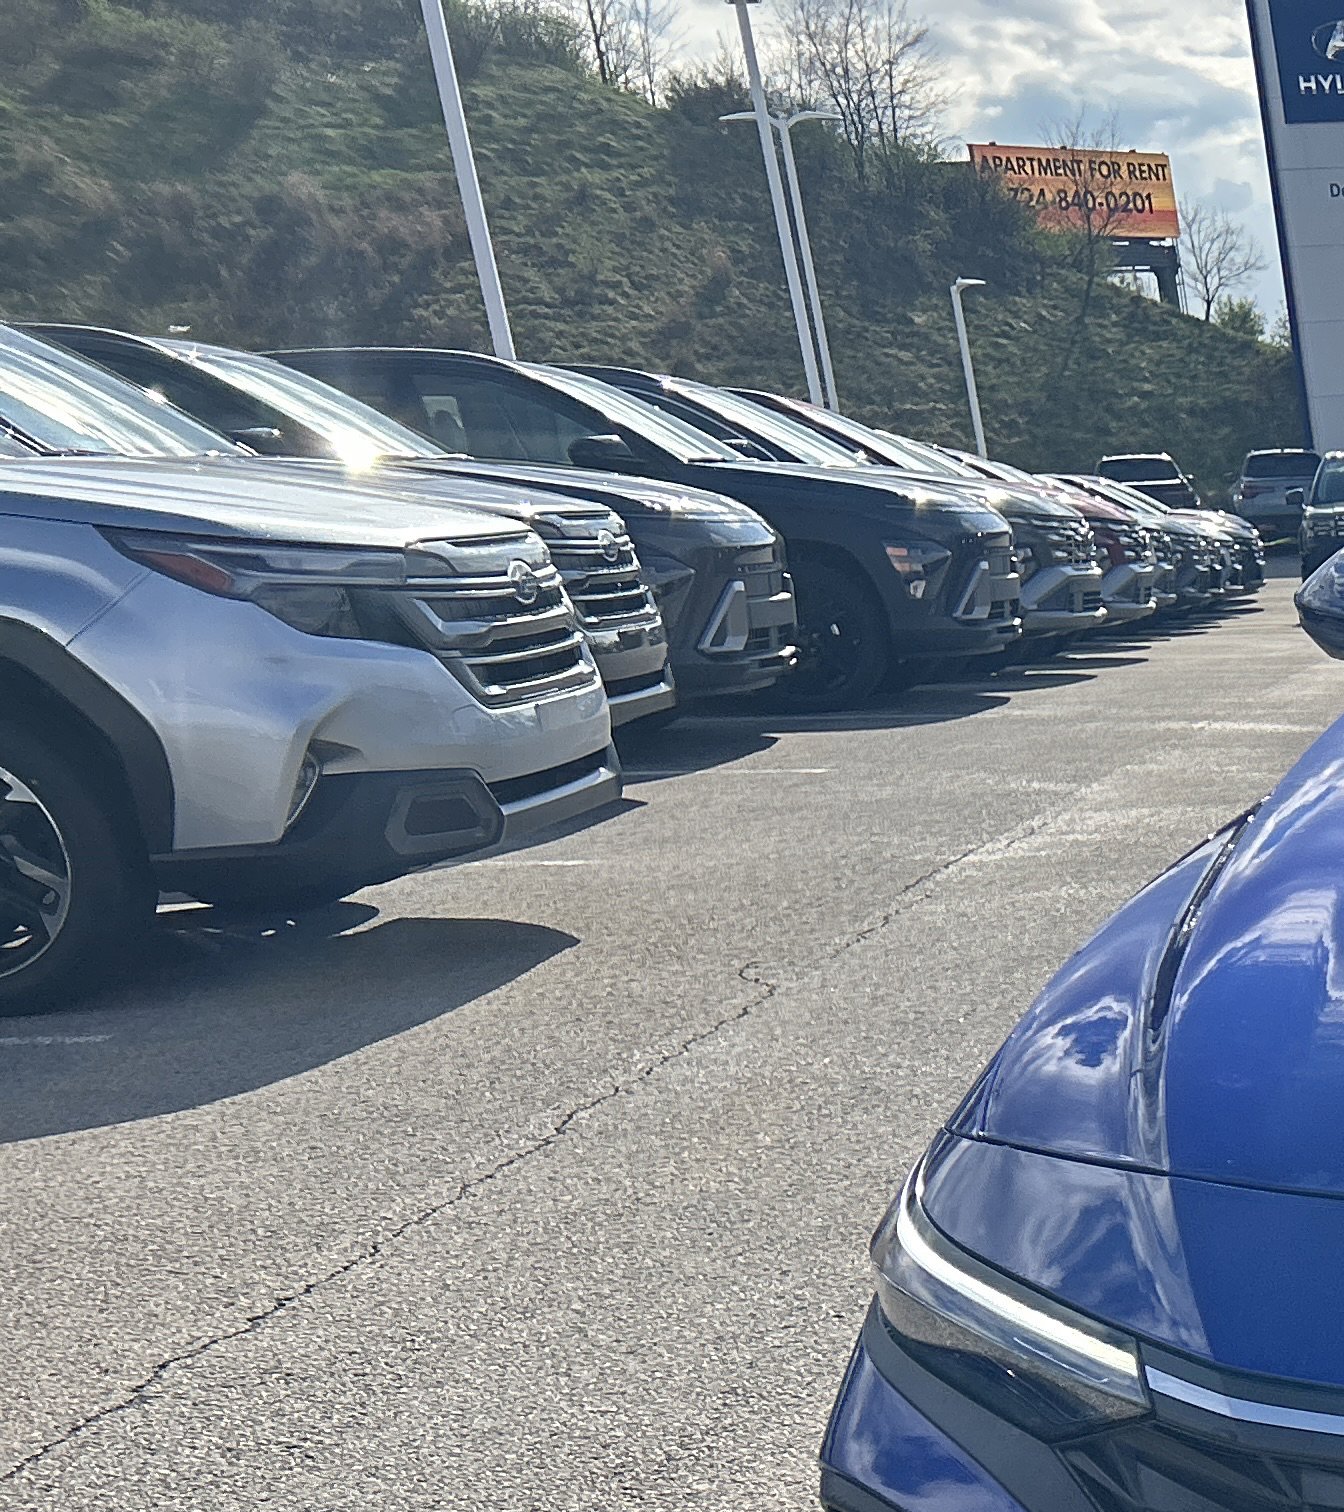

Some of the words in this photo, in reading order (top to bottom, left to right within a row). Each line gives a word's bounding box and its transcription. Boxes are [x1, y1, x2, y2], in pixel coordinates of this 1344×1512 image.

[979, 155, 1083, 177] APARTMENT
[1089, 160, 1123, 180] FOR
[1126, 162, 1168, 182] RENT
